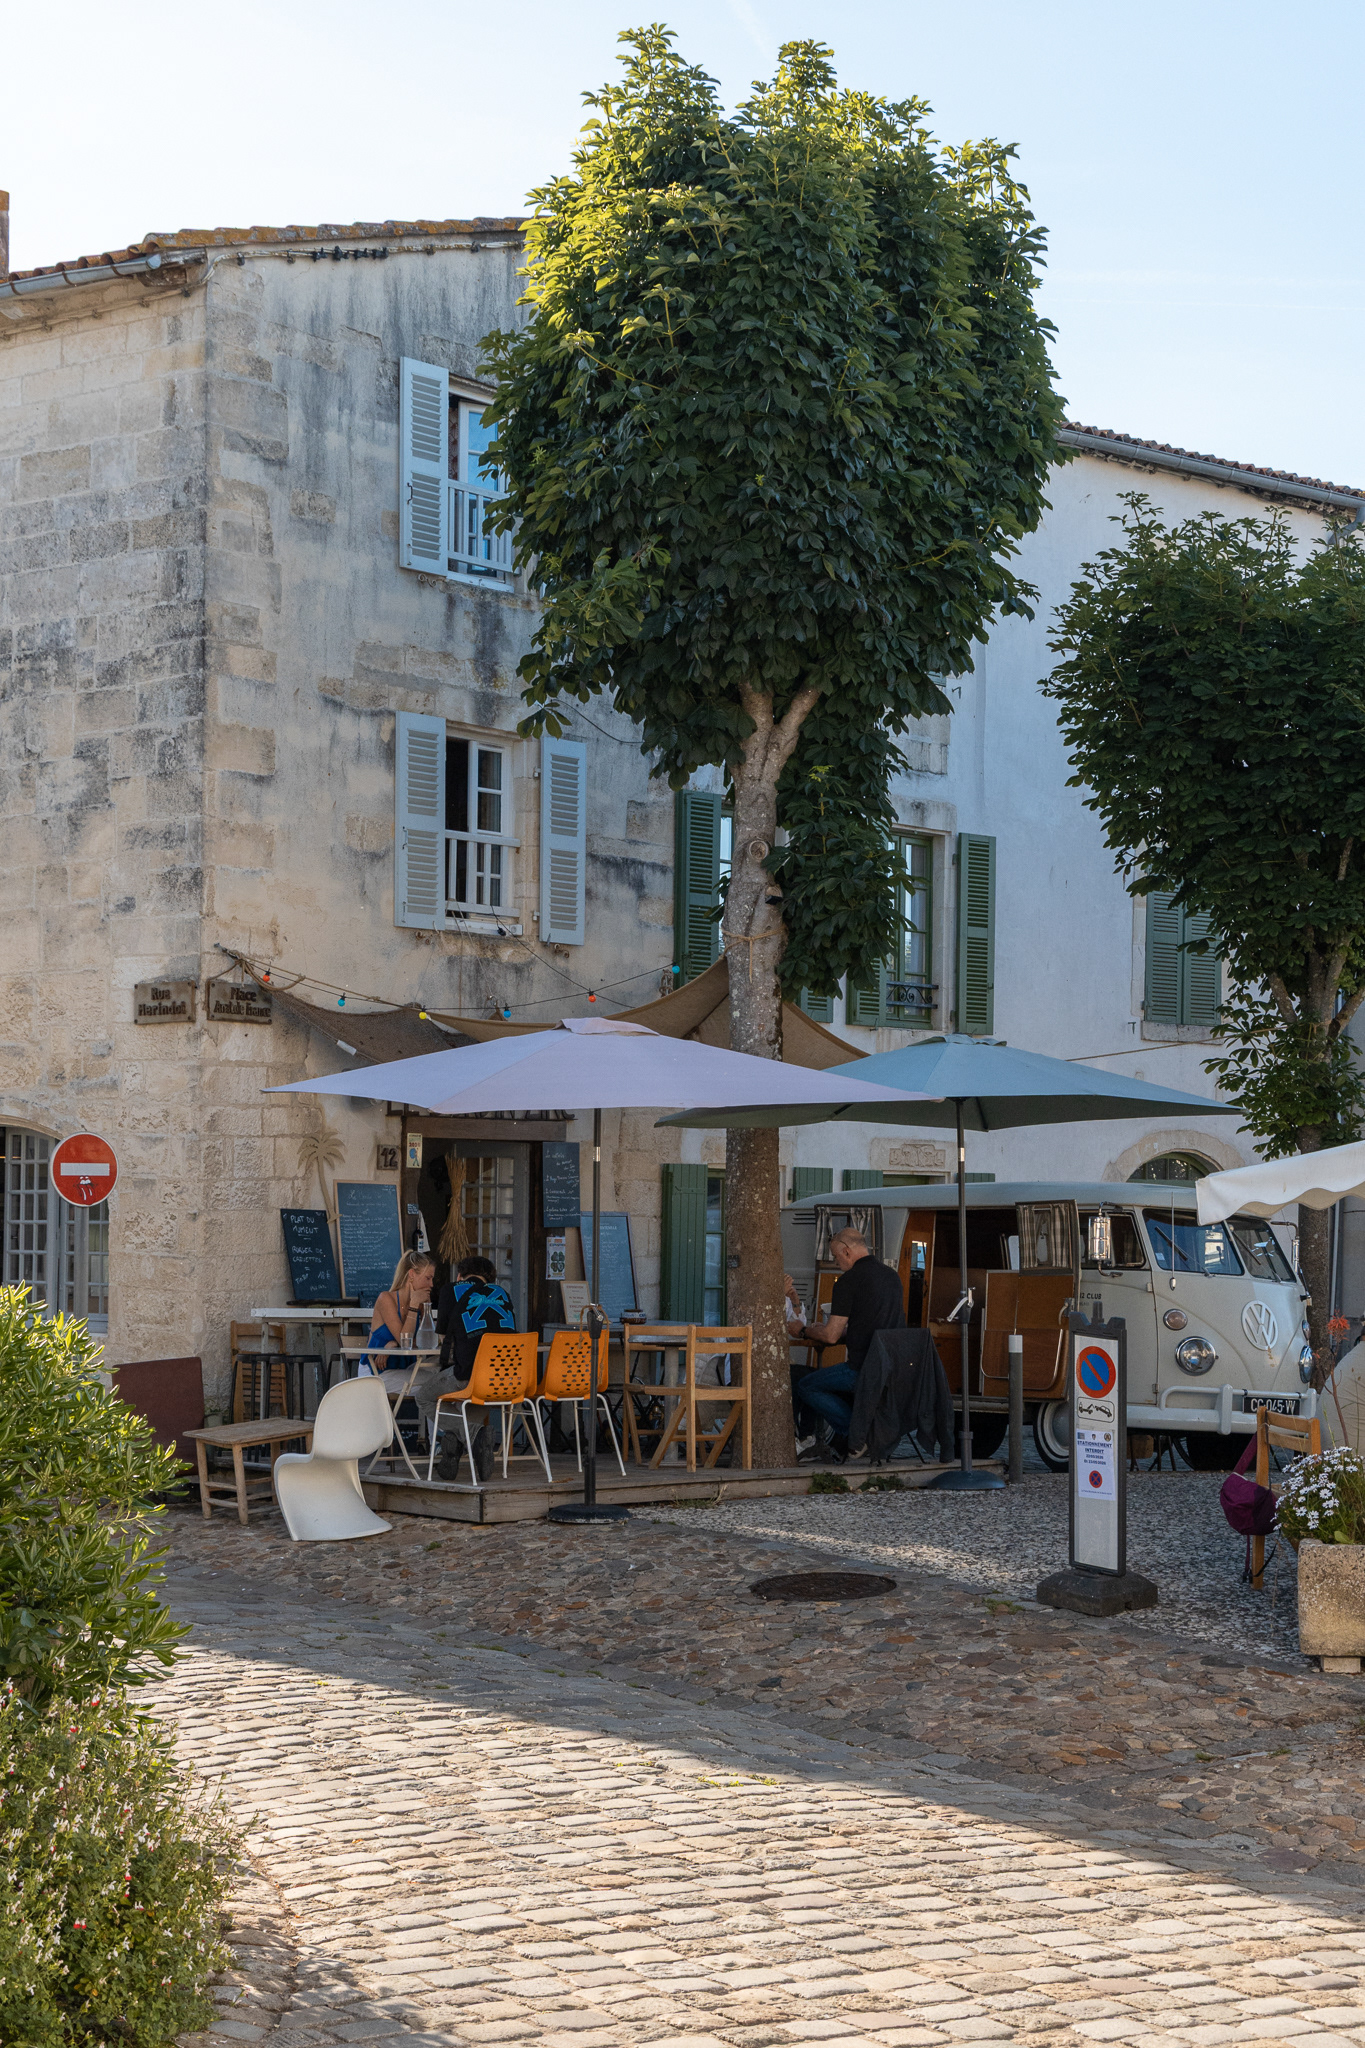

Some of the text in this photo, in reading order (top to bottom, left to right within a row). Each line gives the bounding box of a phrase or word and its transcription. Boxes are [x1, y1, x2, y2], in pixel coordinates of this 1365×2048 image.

[151, 987, 170, 1000] Rue
[231, 987, 257, 1002] Place
[381, 1147, 398, 1168] 12
